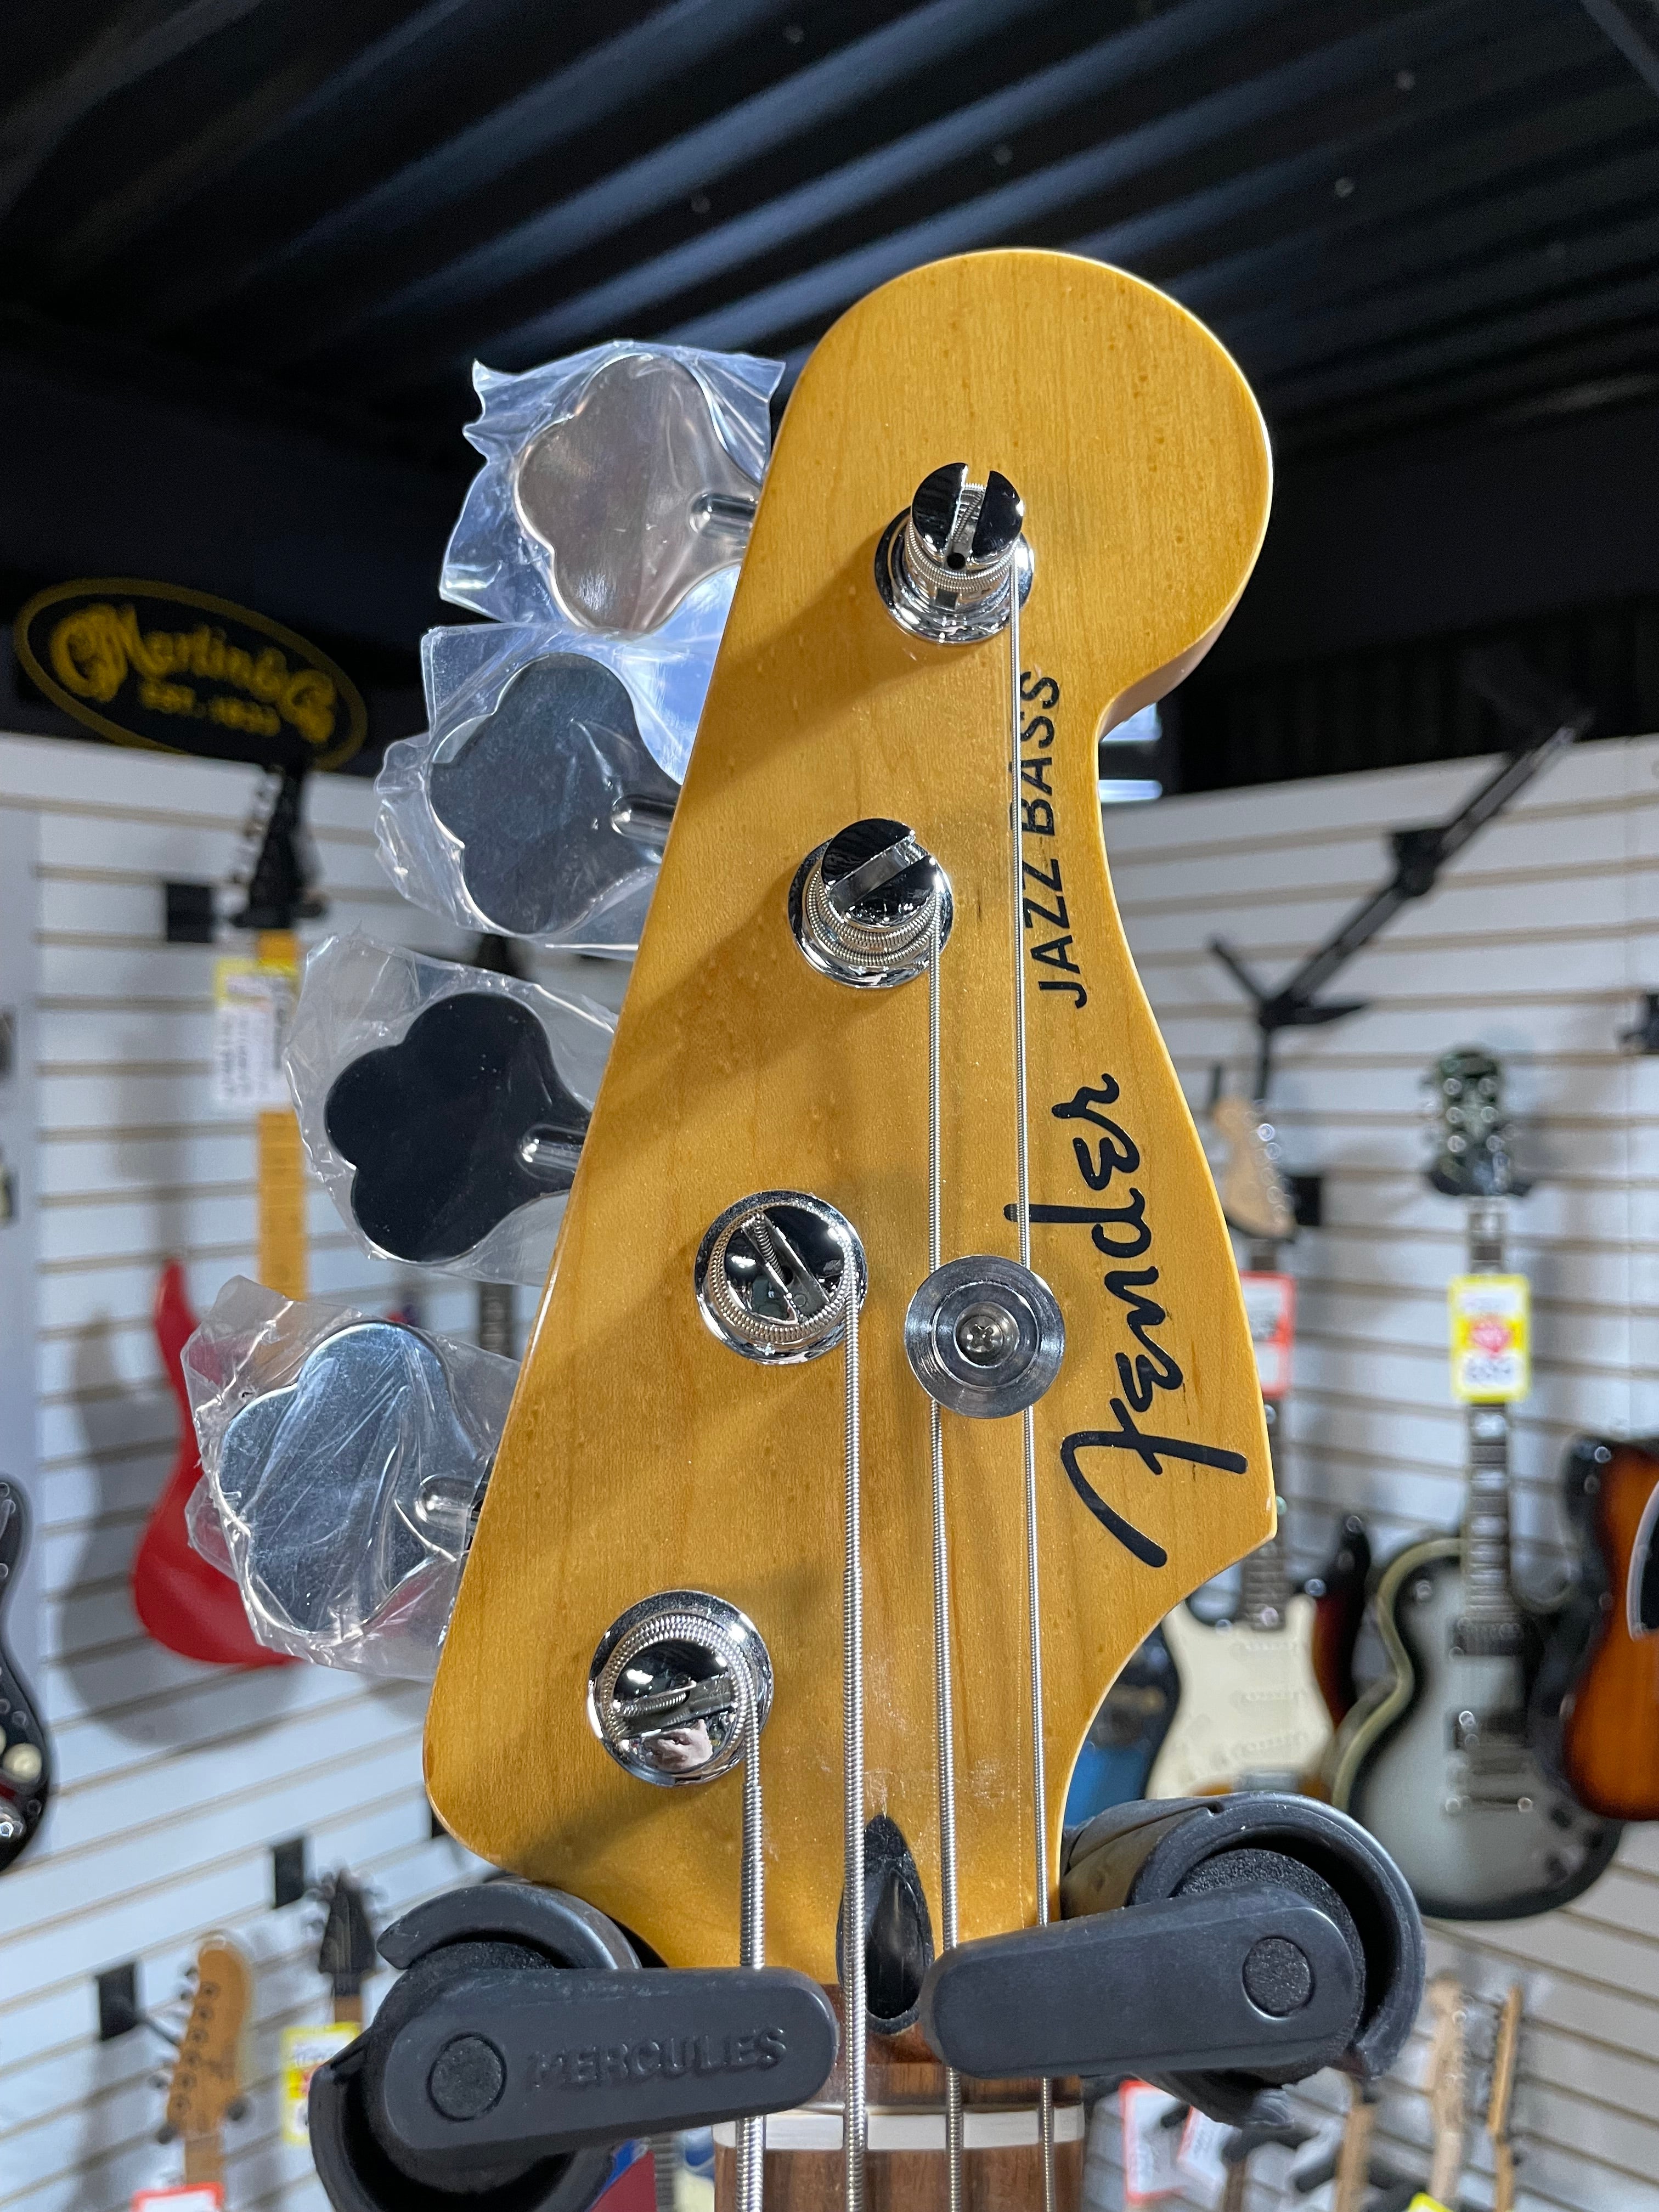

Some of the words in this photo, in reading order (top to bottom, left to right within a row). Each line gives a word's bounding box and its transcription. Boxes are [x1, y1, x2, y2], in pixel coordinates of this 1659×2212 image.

[1010, 671, 1060, 837] BASS
[1022, 859, 1087, 1009] JAZZ
[1003, 1073, 1248, 1568] Fender
[526, 2025, 787, 2089] HERCULES
